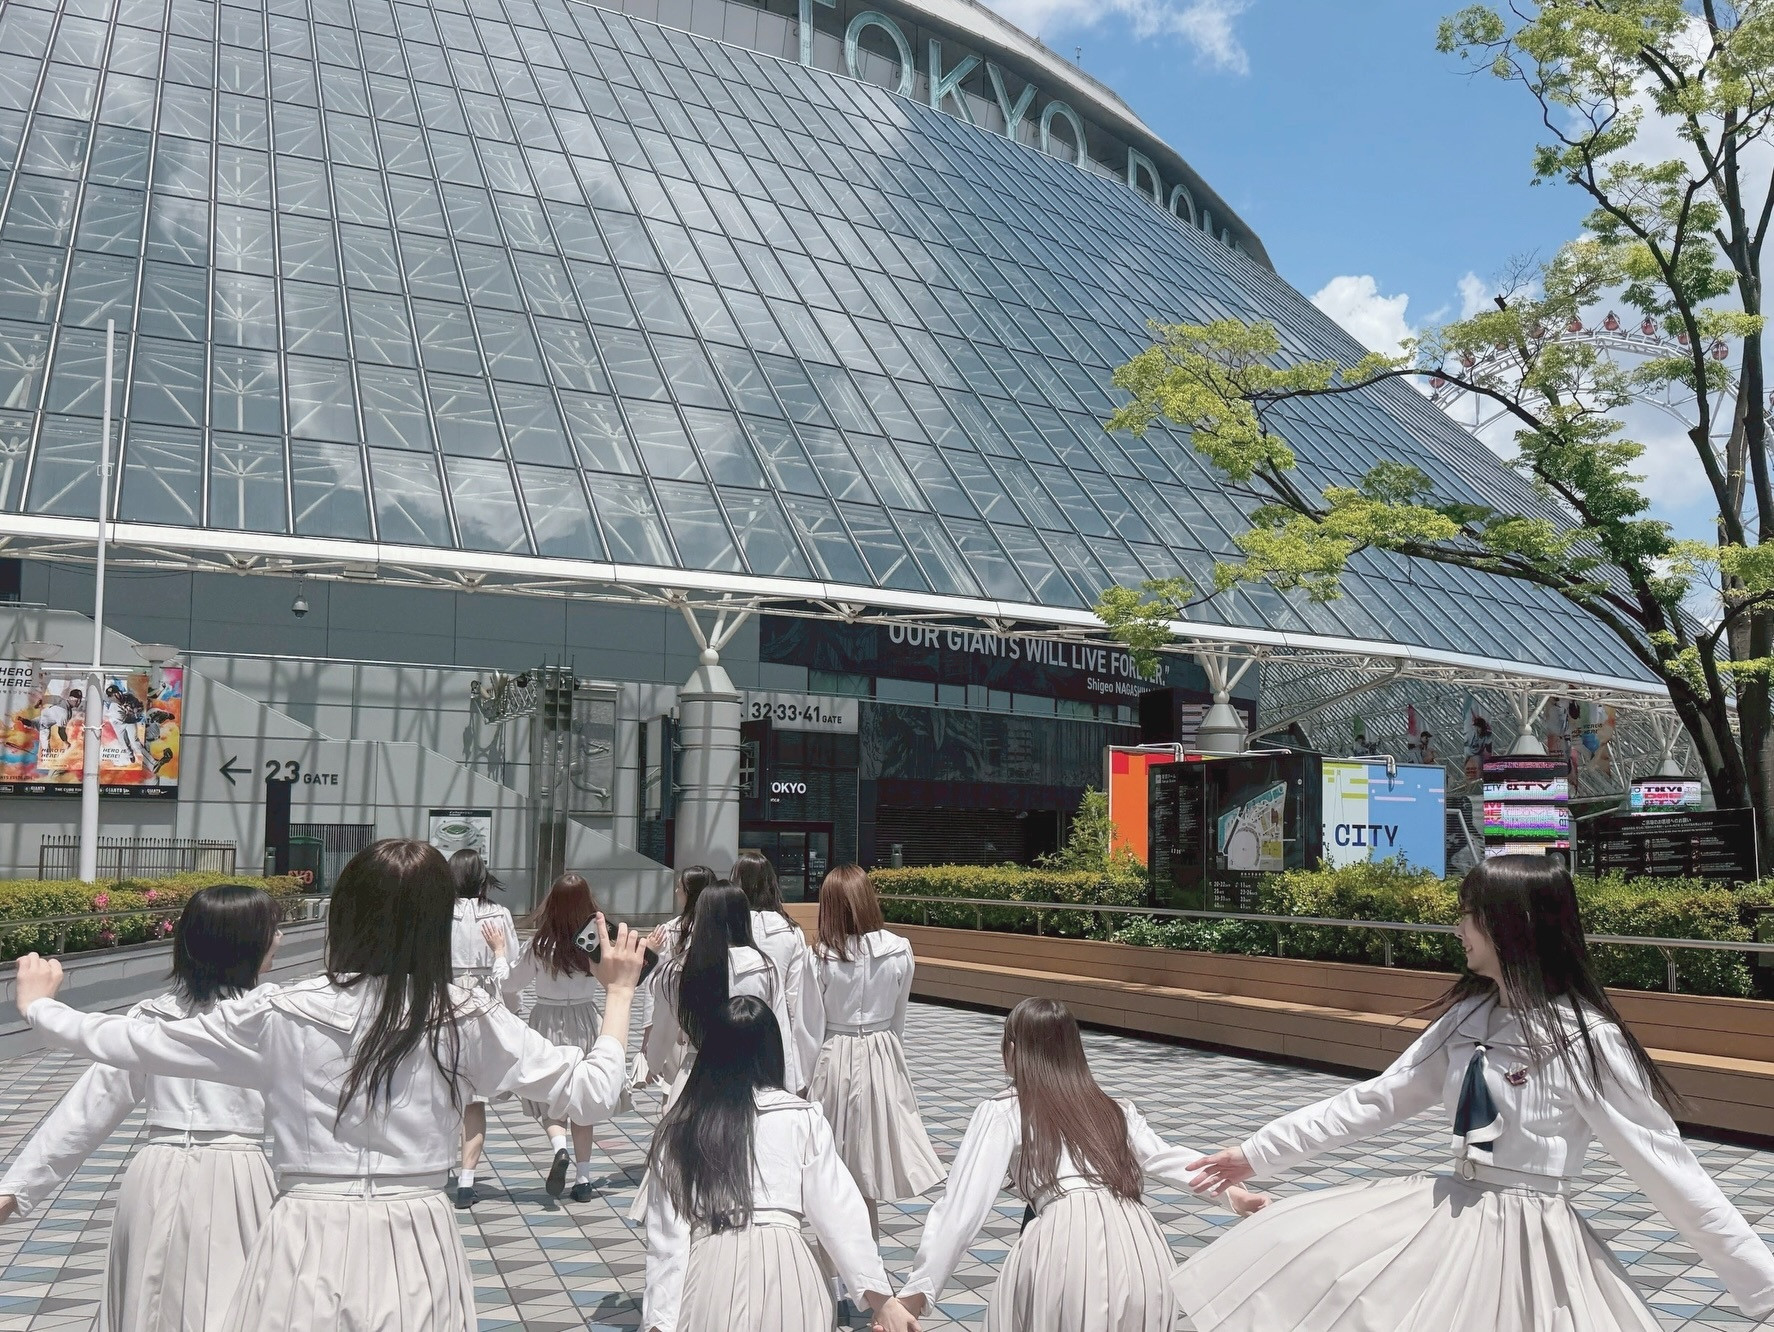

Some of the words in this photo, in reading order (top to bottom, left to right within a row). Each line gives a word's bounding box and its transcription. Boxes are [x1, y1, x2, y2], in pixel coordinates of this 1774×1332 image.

[947, 629, 1020, 659] GIANTS
[1025, 637, 1068, 667] WILL
[1072, 645, 1107, 673] LIVE
[1087, 677, 1113, 695] Shigeo
[822, 715, 842, 723] GATE
[265, 760, 300, 784] 23
[303, 774, 338, 785] GATE
[770, 782, 807, 794] OKYO
[1335, 824, 1398, 847] CITY
